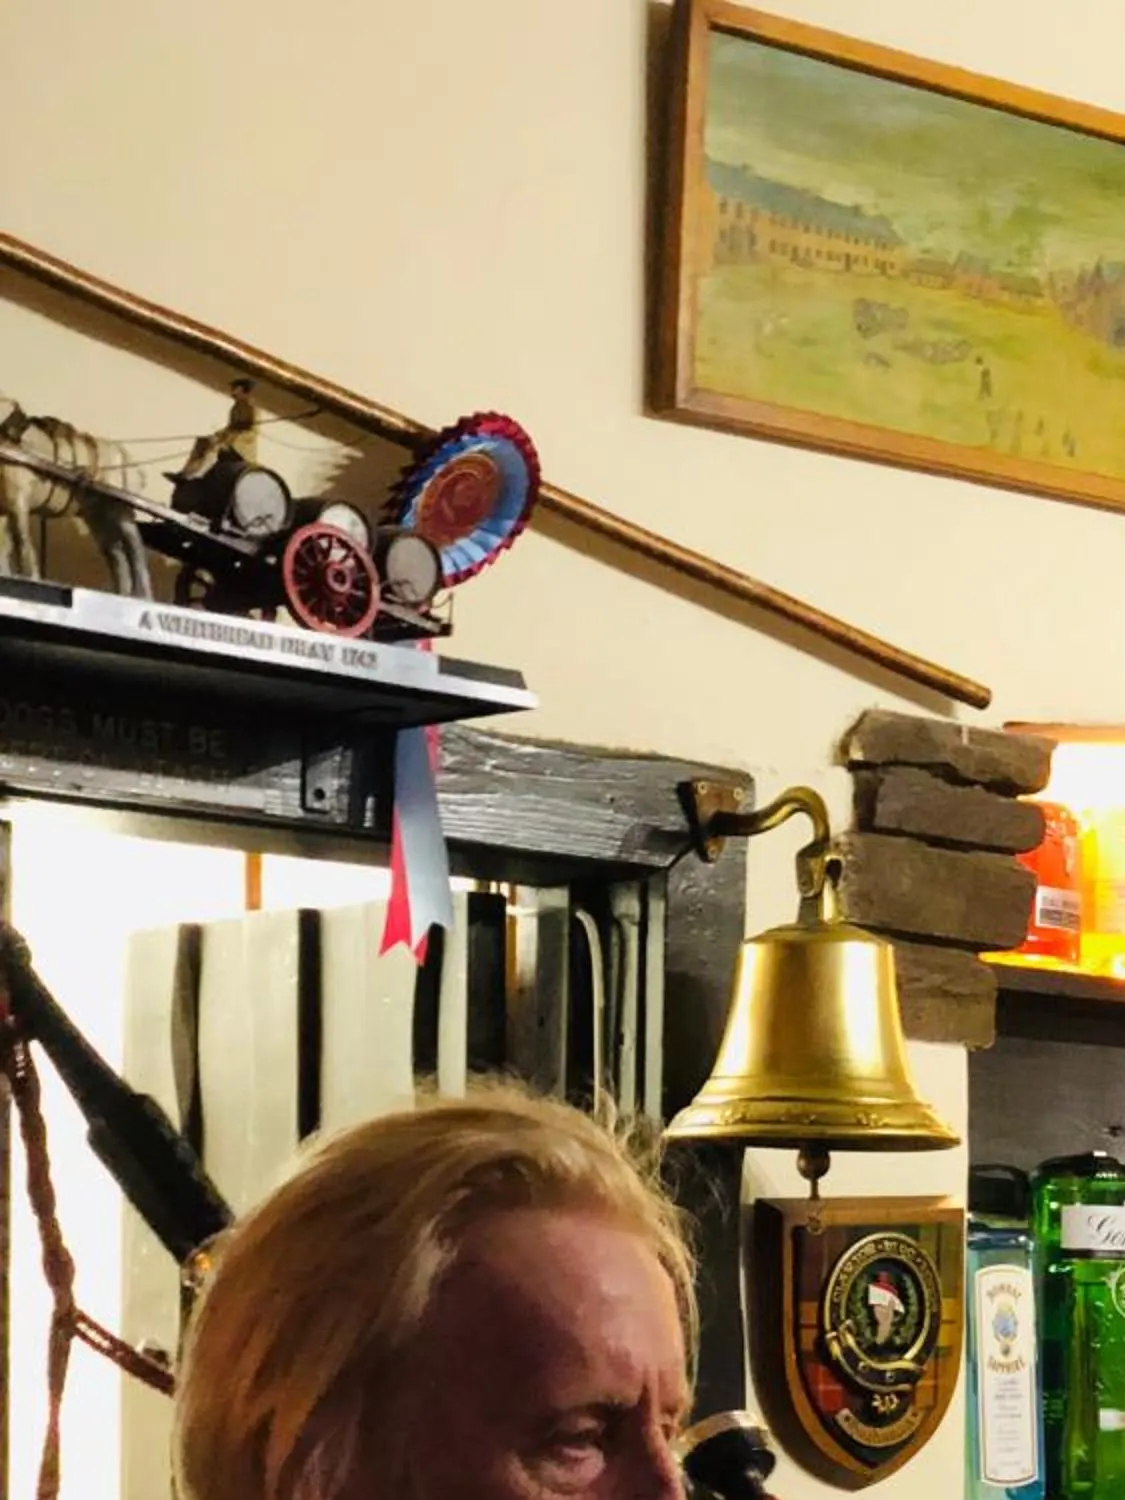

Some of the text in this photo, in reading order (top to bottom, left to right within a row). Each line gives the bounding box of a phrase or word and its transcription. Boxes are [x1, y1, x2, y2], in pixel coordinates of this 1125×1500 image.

[138, 609, 152, 631] A
[92, 711, 177, 748] MUST
[187, 724, 228, 759] BE
